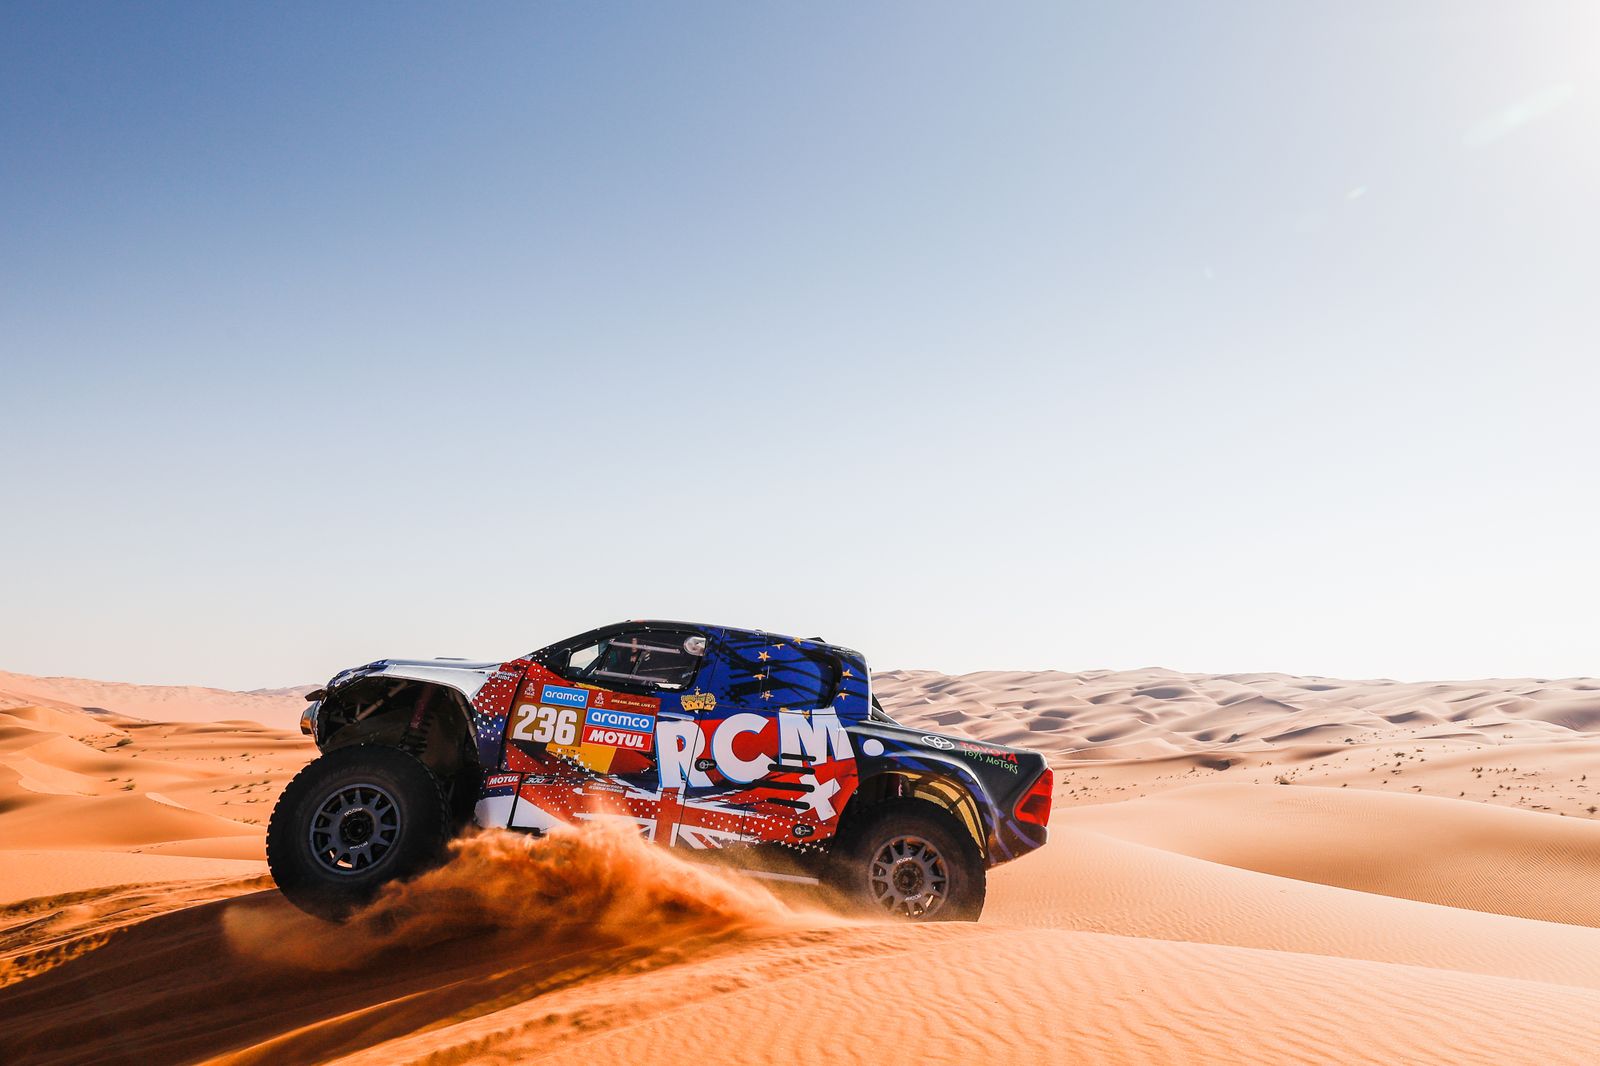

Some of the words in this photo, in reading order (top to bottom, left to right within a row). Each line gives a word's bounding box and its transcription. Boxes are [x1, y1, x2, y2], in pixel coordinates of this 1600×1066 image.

[545, 689, 585, 702] aramco
[512, 704, 578, 745] 236
[591, 711, 650, 729] aramco
[589, 729, 645, 748] MOTUL
[655, 706, 855, 788] RCM
[959, 741, 1019, 765] TOYOTA
[489, 775, 519, 785] MOTUL
